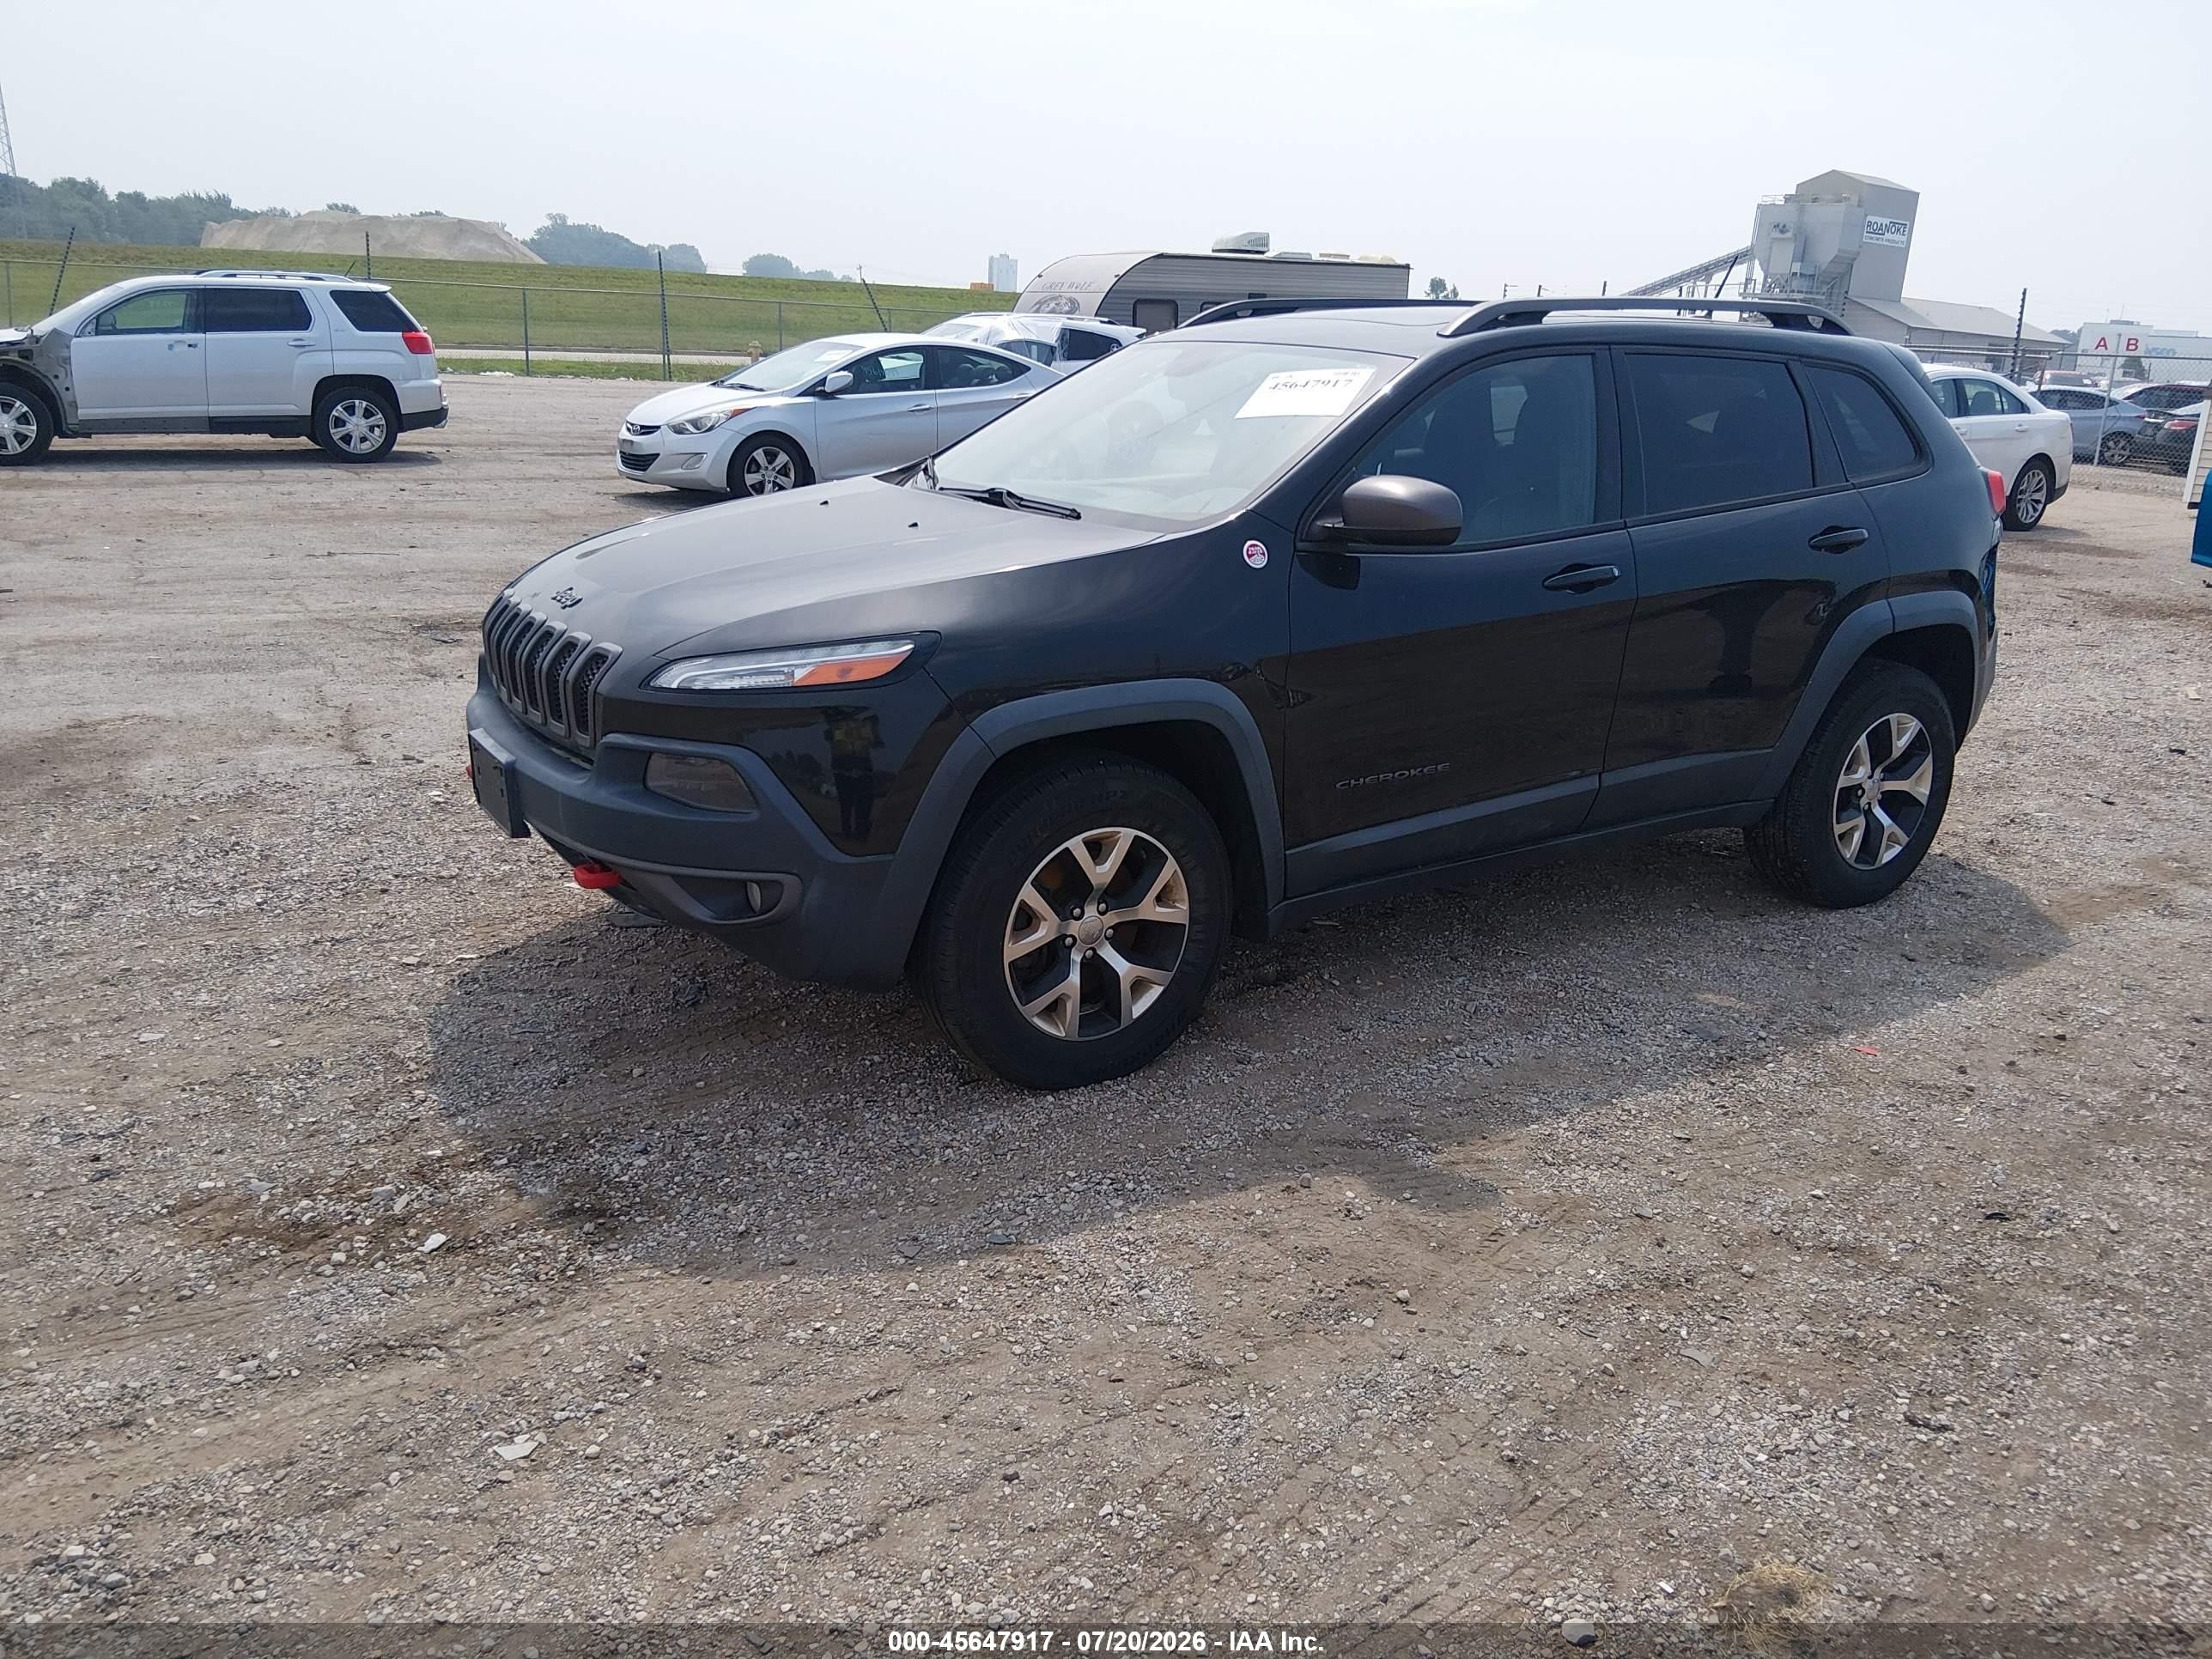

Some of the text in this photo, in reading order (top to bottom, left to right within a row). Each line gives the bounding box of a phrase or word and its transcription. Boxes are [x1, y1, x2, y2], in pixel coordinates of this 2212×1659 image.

[1866, 221, 1908, 236] ROANOKE
[1042, 281, 1065, 290] GREY
[2095, 337, 2108, 350] A
[2125, 337, 2140, 352] B
[1268, 379, 1353, 392] 45647917
[550, 586, 584, 610] Jeep
[1335, 763, 1451, 790] CHEROKEE
